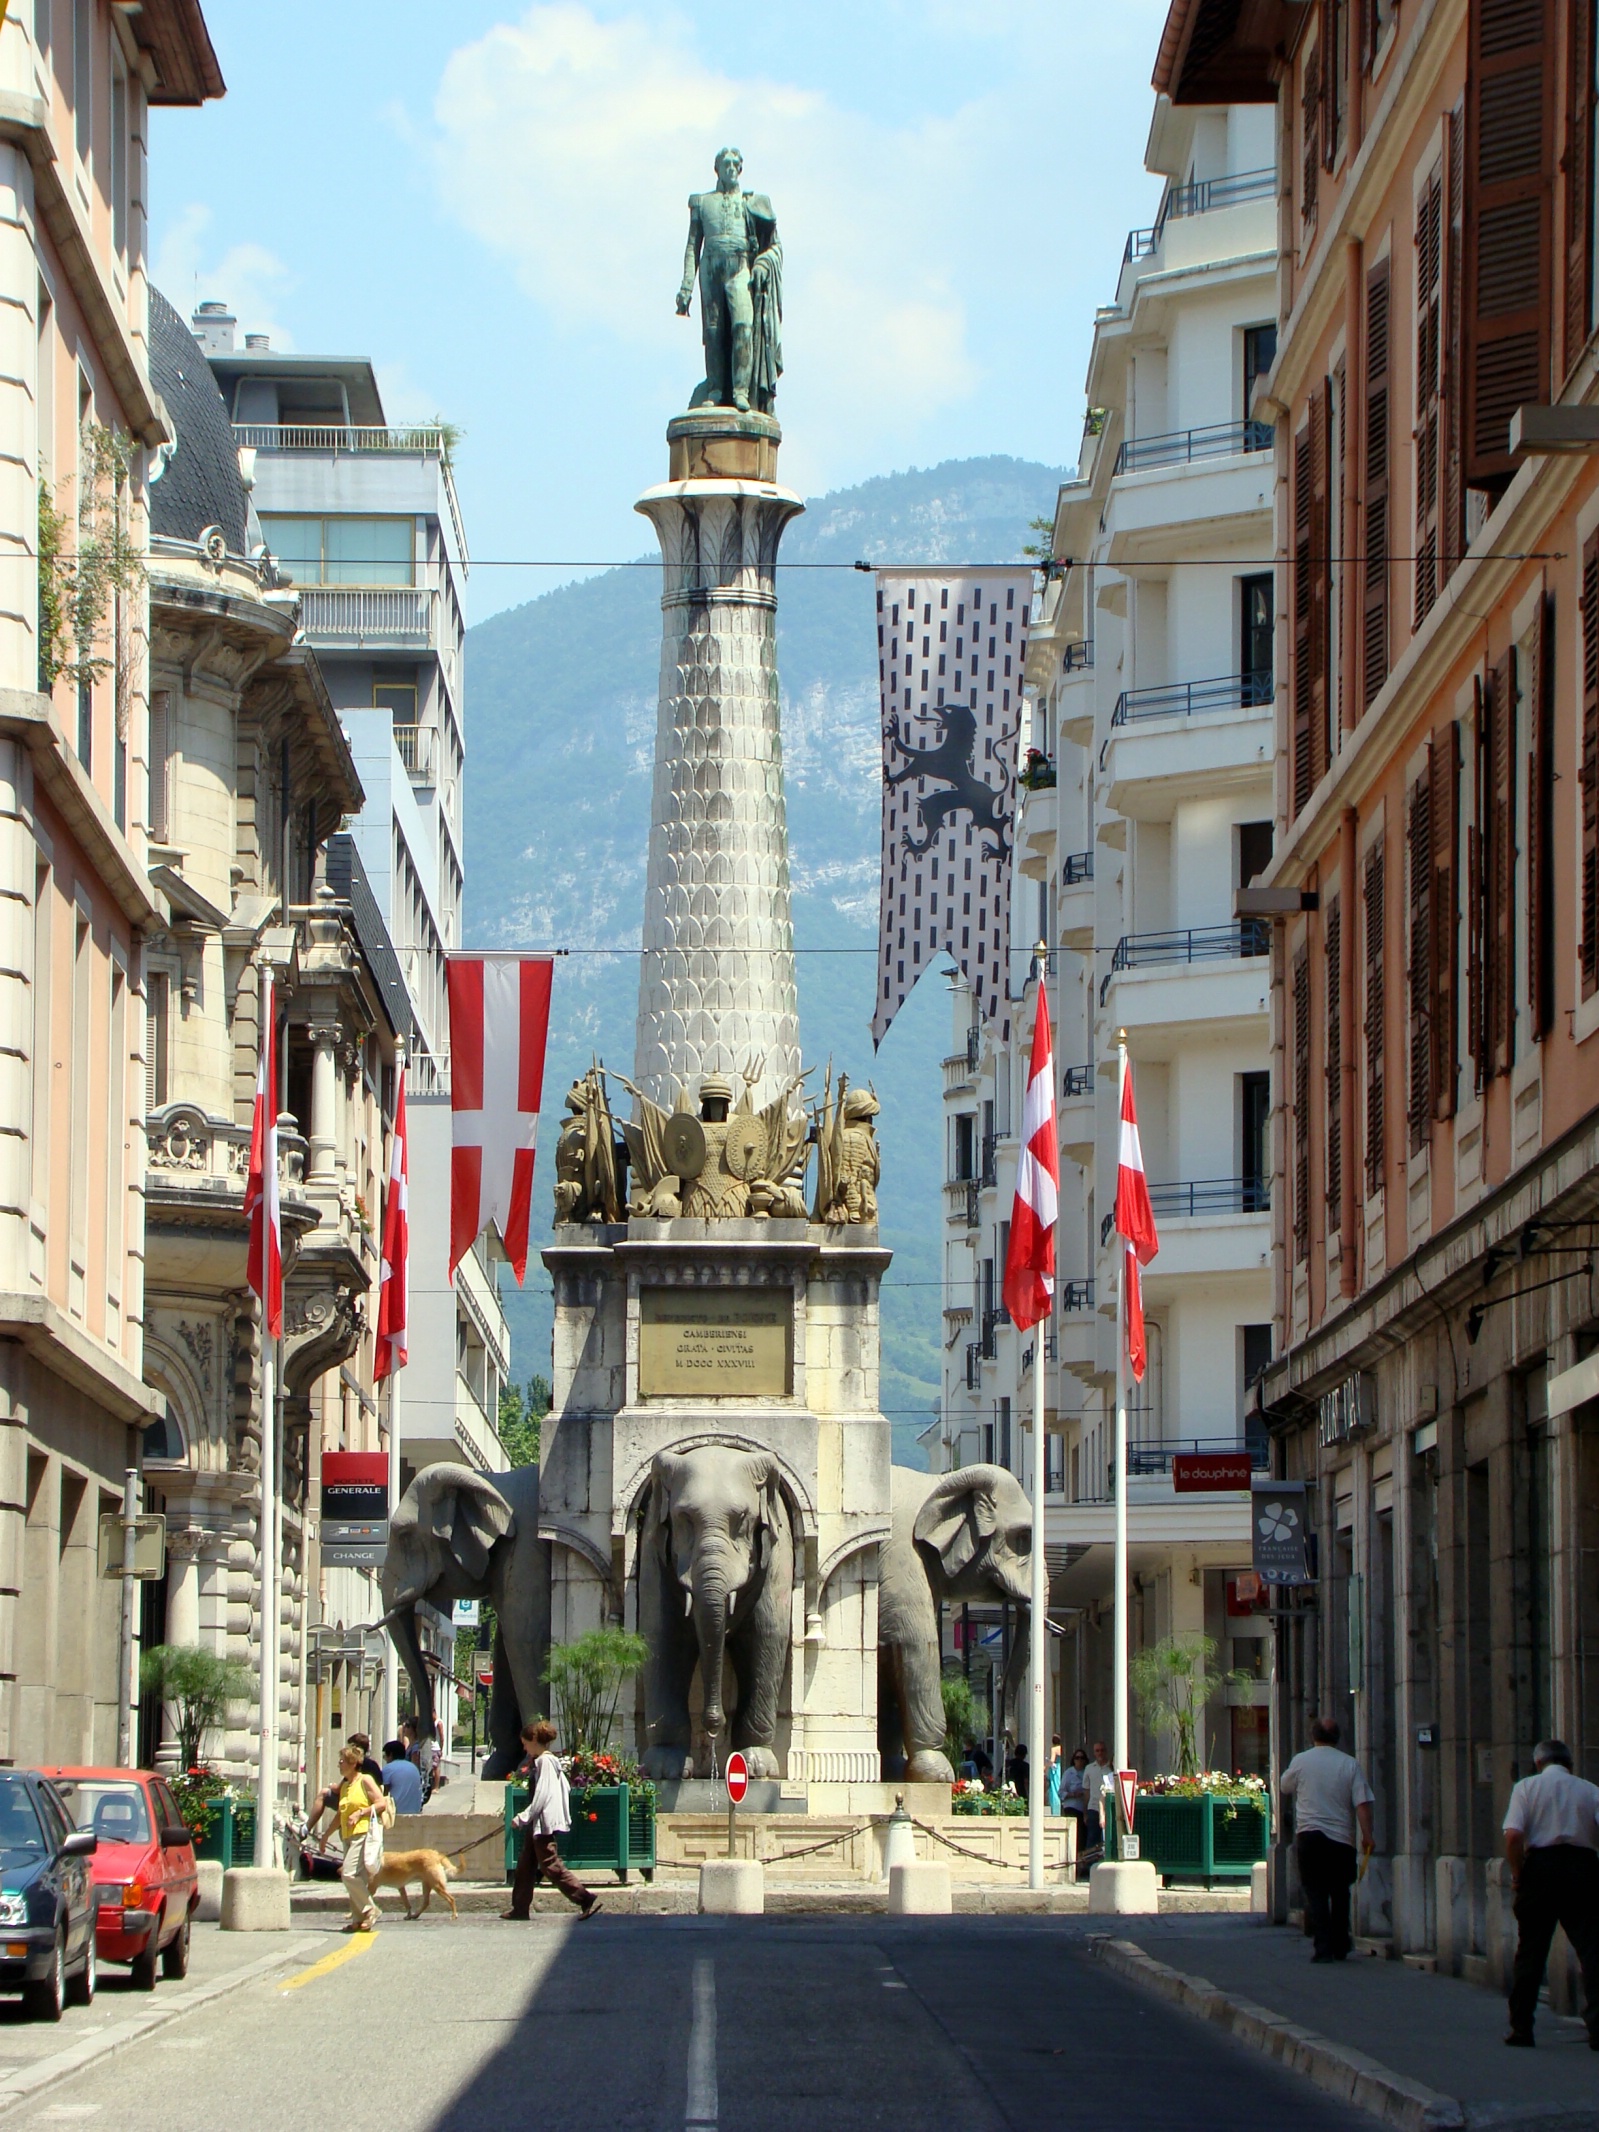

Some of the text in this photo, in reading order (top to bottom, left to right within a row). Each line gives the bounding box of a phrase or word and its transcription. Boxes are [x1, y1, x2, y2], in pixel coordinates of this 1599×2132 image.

[683, 1330, 747, 1339] CAMBERIENSI
[677, 1344, 754, 1353] GRATA CIVITAS
[1180, 1468, 1191, 1479] le
[333, 1552, 375, 1560] CHANGE
